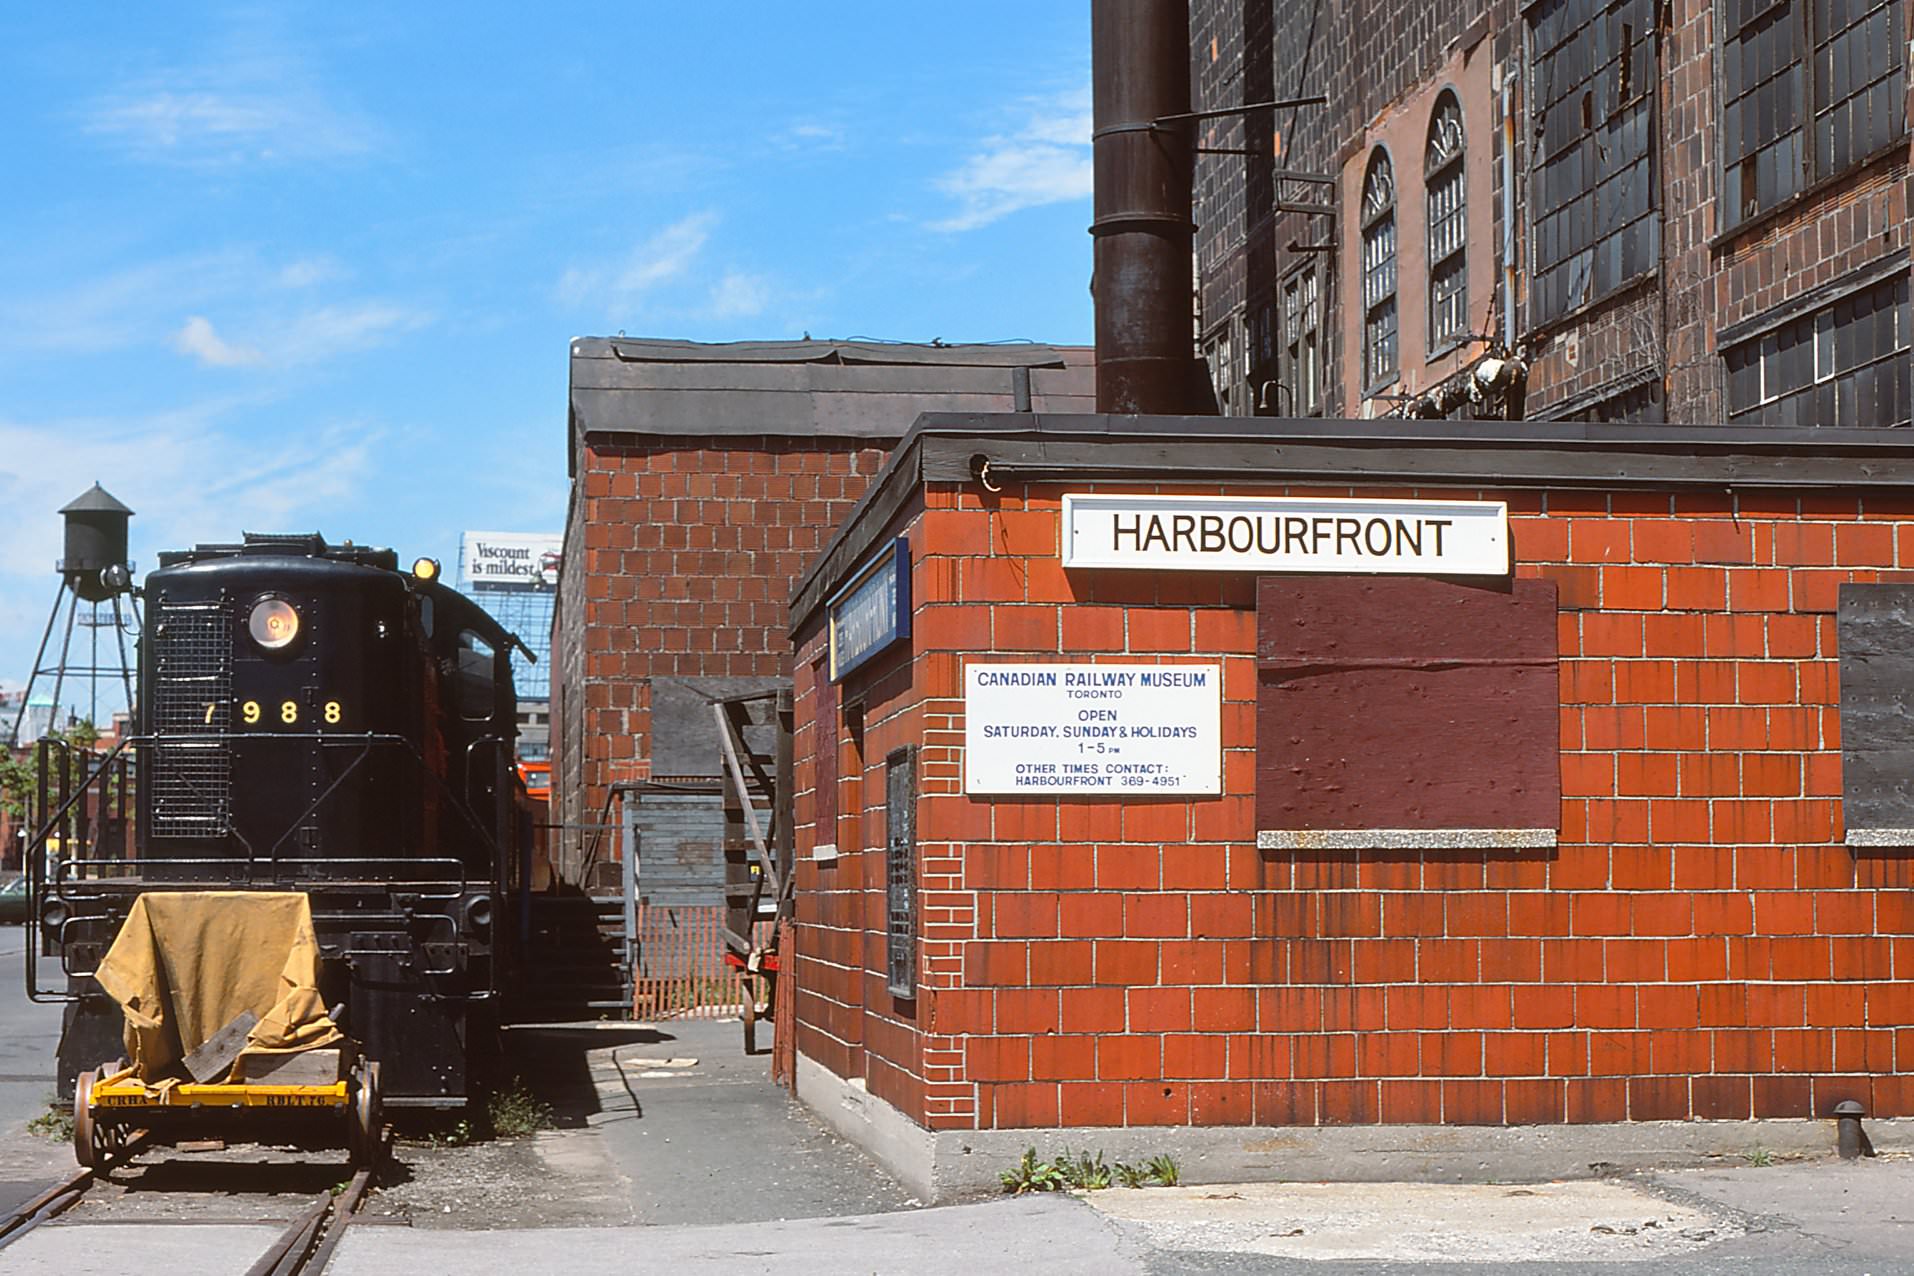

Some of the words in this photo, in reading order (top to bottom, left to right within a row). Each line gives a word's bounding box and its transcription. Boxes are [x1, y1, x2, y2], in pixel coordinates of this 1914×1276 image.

[1113, 513, 1453, 557] HARBOURFRONT
[476, 542, 530, 559] Viscount
[472, 559, 482, 574] is
[977, 672, 1057, 687] CANADIAN
[1065, 672, 1136, 687] RAILWAY
[1140, 672, 1206, 687] MUSEUM
[1066, 690, 1122, 699] TORONTO
[1078, 710, 1117, 721] OPEN
[1131, 726, 1197, 738] HOLIDAYS
[1015, 764, 1057, 774] OTHER
[1062, 764, 1099, 774] TIMES
[1105, 764, 1169, 774] CONTACT:
[1015, 776, 1112, 786] HARBOURFRONT
[1120, 776, 1180, 786] 369-4951
[107, 1096, 147, 1105] CRHA
